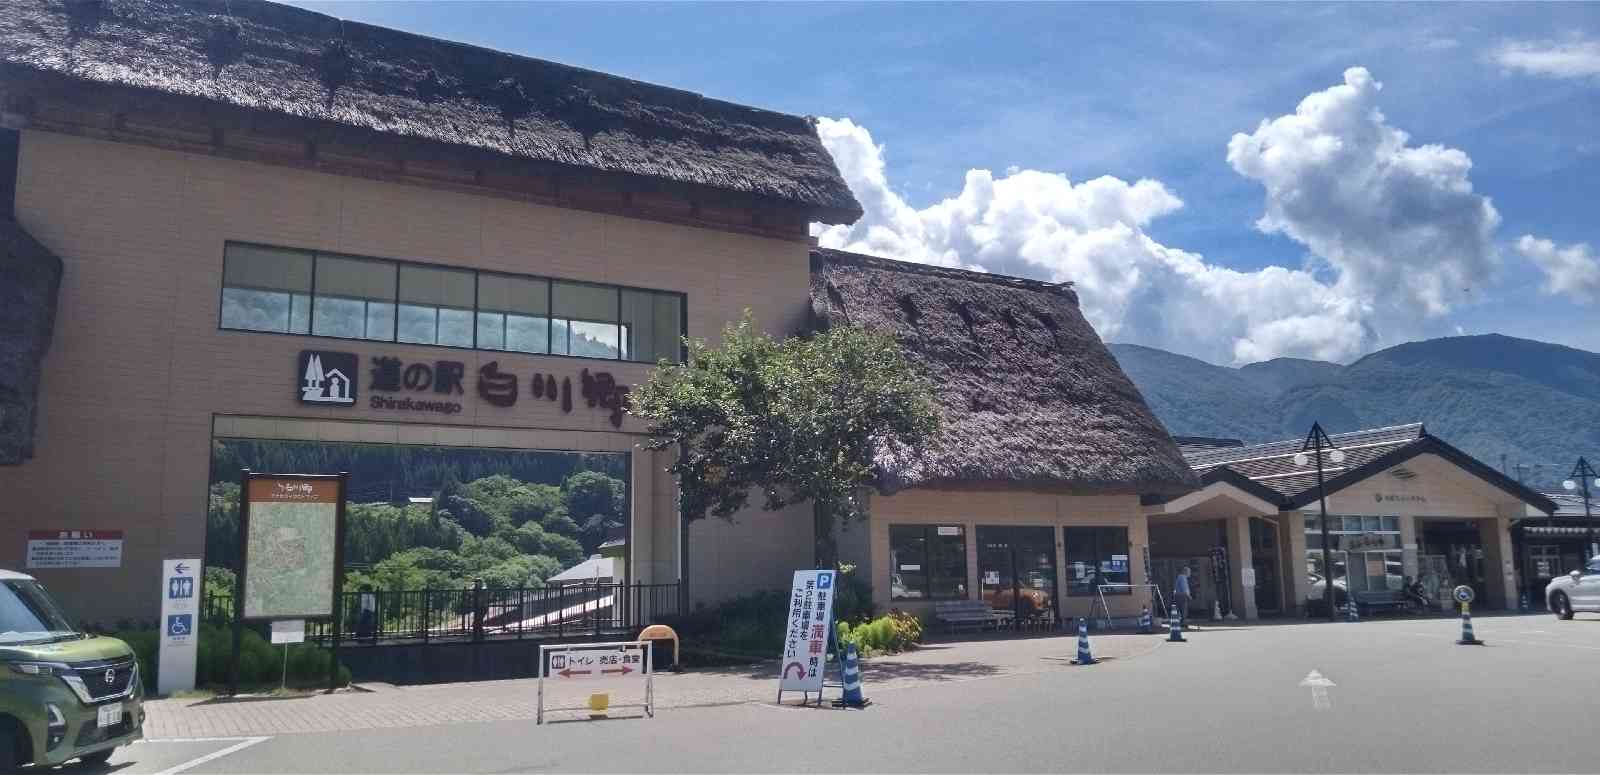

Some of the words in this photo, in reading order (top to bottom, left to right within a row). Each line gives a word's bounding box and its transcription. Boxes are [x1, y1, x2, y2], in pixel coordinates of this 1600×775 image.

[370, 356, 465, 394] 道の駅
[369, 395, 462, 414] Shirakawago
[787, 588, 804, 658] ご利用ください
[569, 655, 594, 665] トイレ
